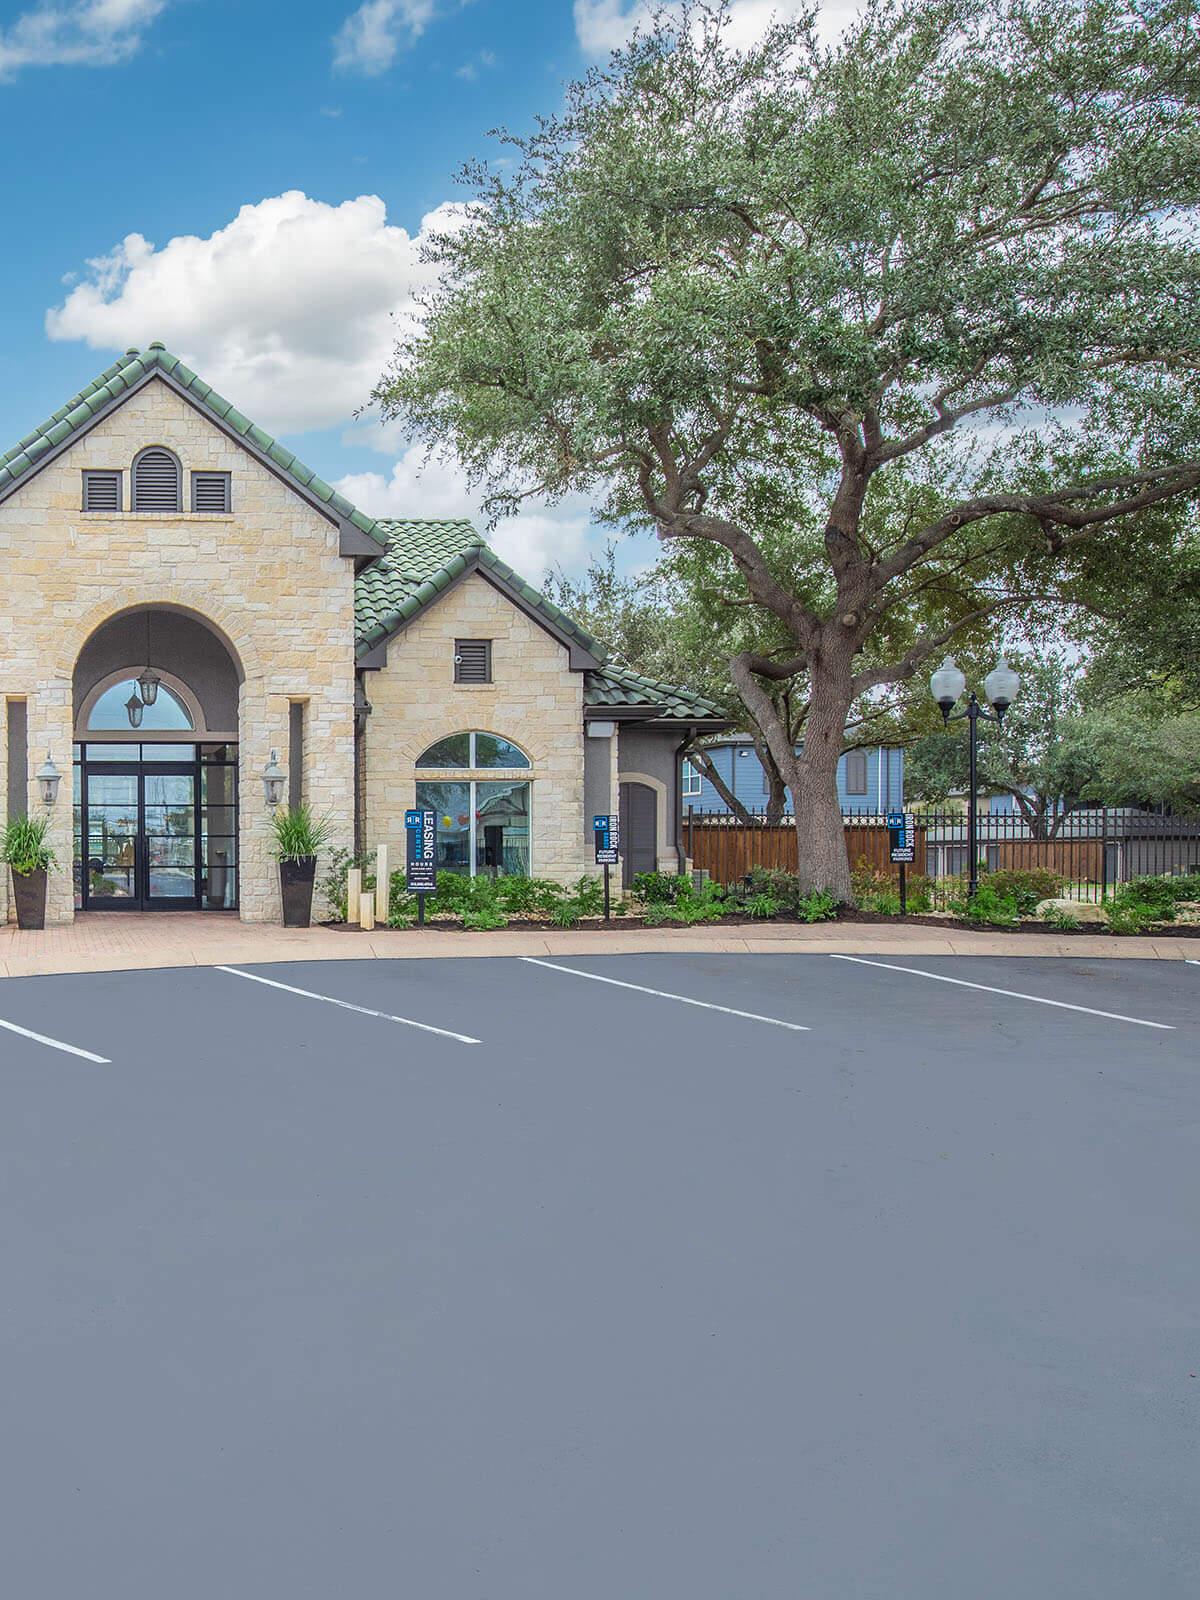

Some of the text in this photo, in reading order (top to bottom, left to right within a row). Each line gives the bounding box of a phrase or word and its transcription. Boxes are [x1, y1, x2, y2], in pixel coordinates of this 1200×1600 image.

[424, 811, 434, 859] LEASING
[609, 816, 618, 849] IRON ROCK
[905, 814, 915, 848] IRON ROCK
